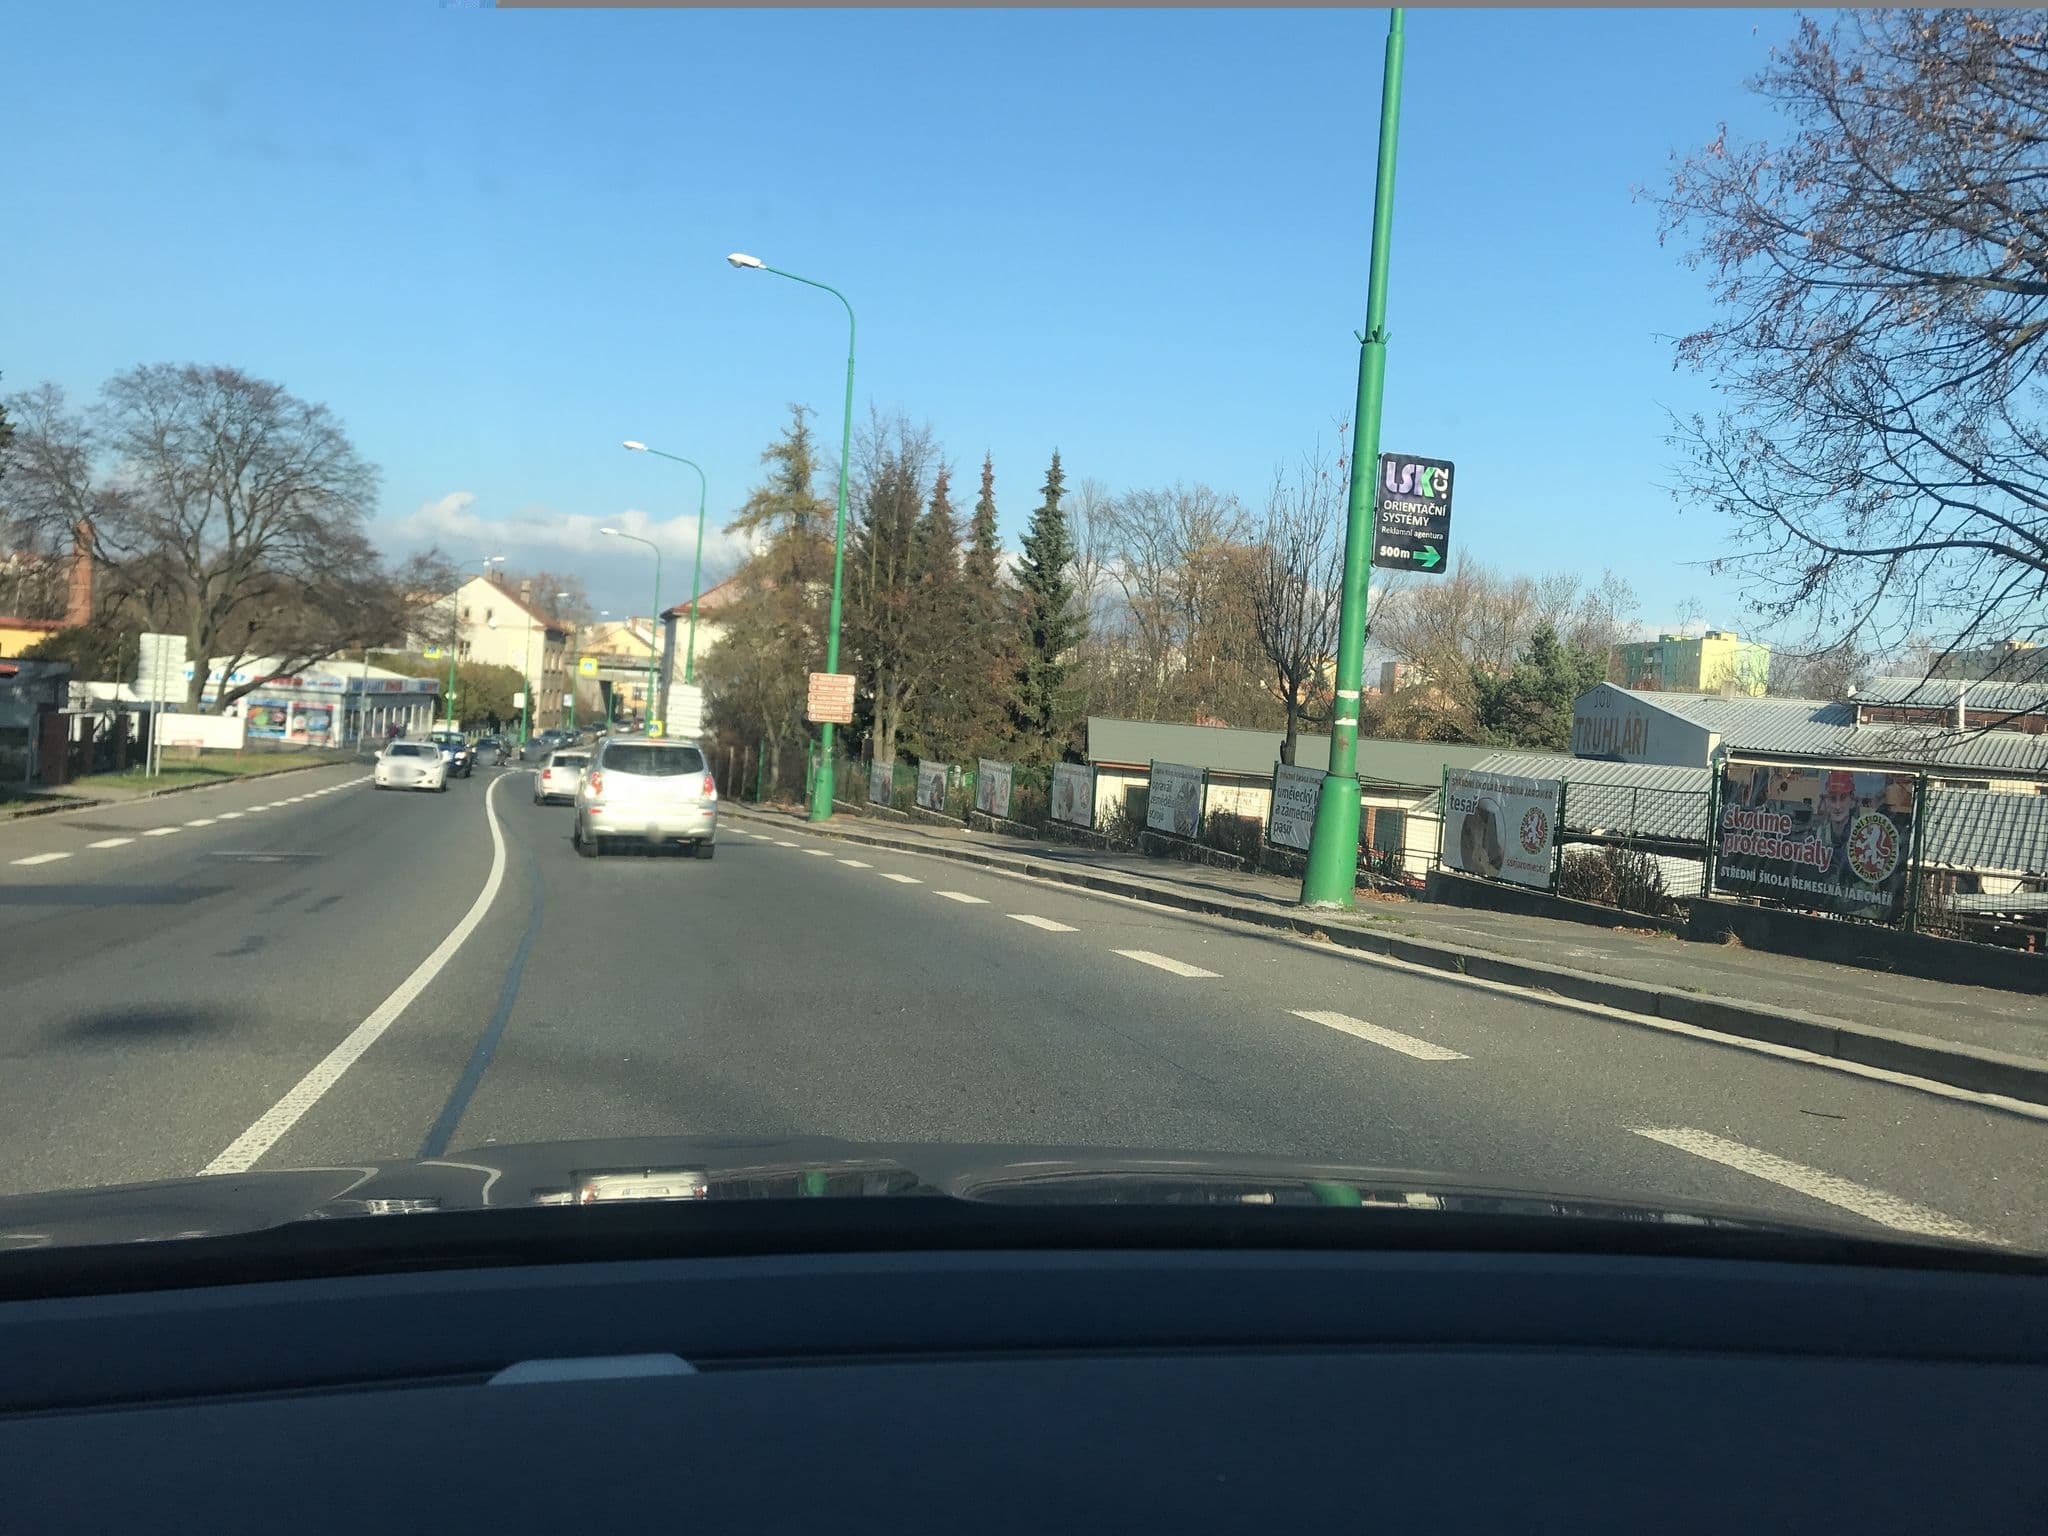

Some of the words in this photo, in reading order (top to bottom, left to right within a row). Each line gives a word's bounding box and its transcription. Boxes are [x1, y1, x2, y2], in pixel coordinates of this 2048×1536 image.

[1383, 500, 1447, 516] ORIENTAČNÍ
[1382, 512, 1430, 527] SYSTÉMY
[1381, 526, 1413, 537] Reklamní
[1413, 531, 1444, 540] agentura
[1450, 795, 1478, 813] tesař
[1722, 831, 1833, 872] profesionály
[1720, 865, 1756, 882] STŘEDNÍ
[1758, 869, 1790, 888] ŠKOLA
[1791, 874, 1843, 897] ŘEMESLNÁ
[1843, 886, 1893, 906] JAROMĚŘ
